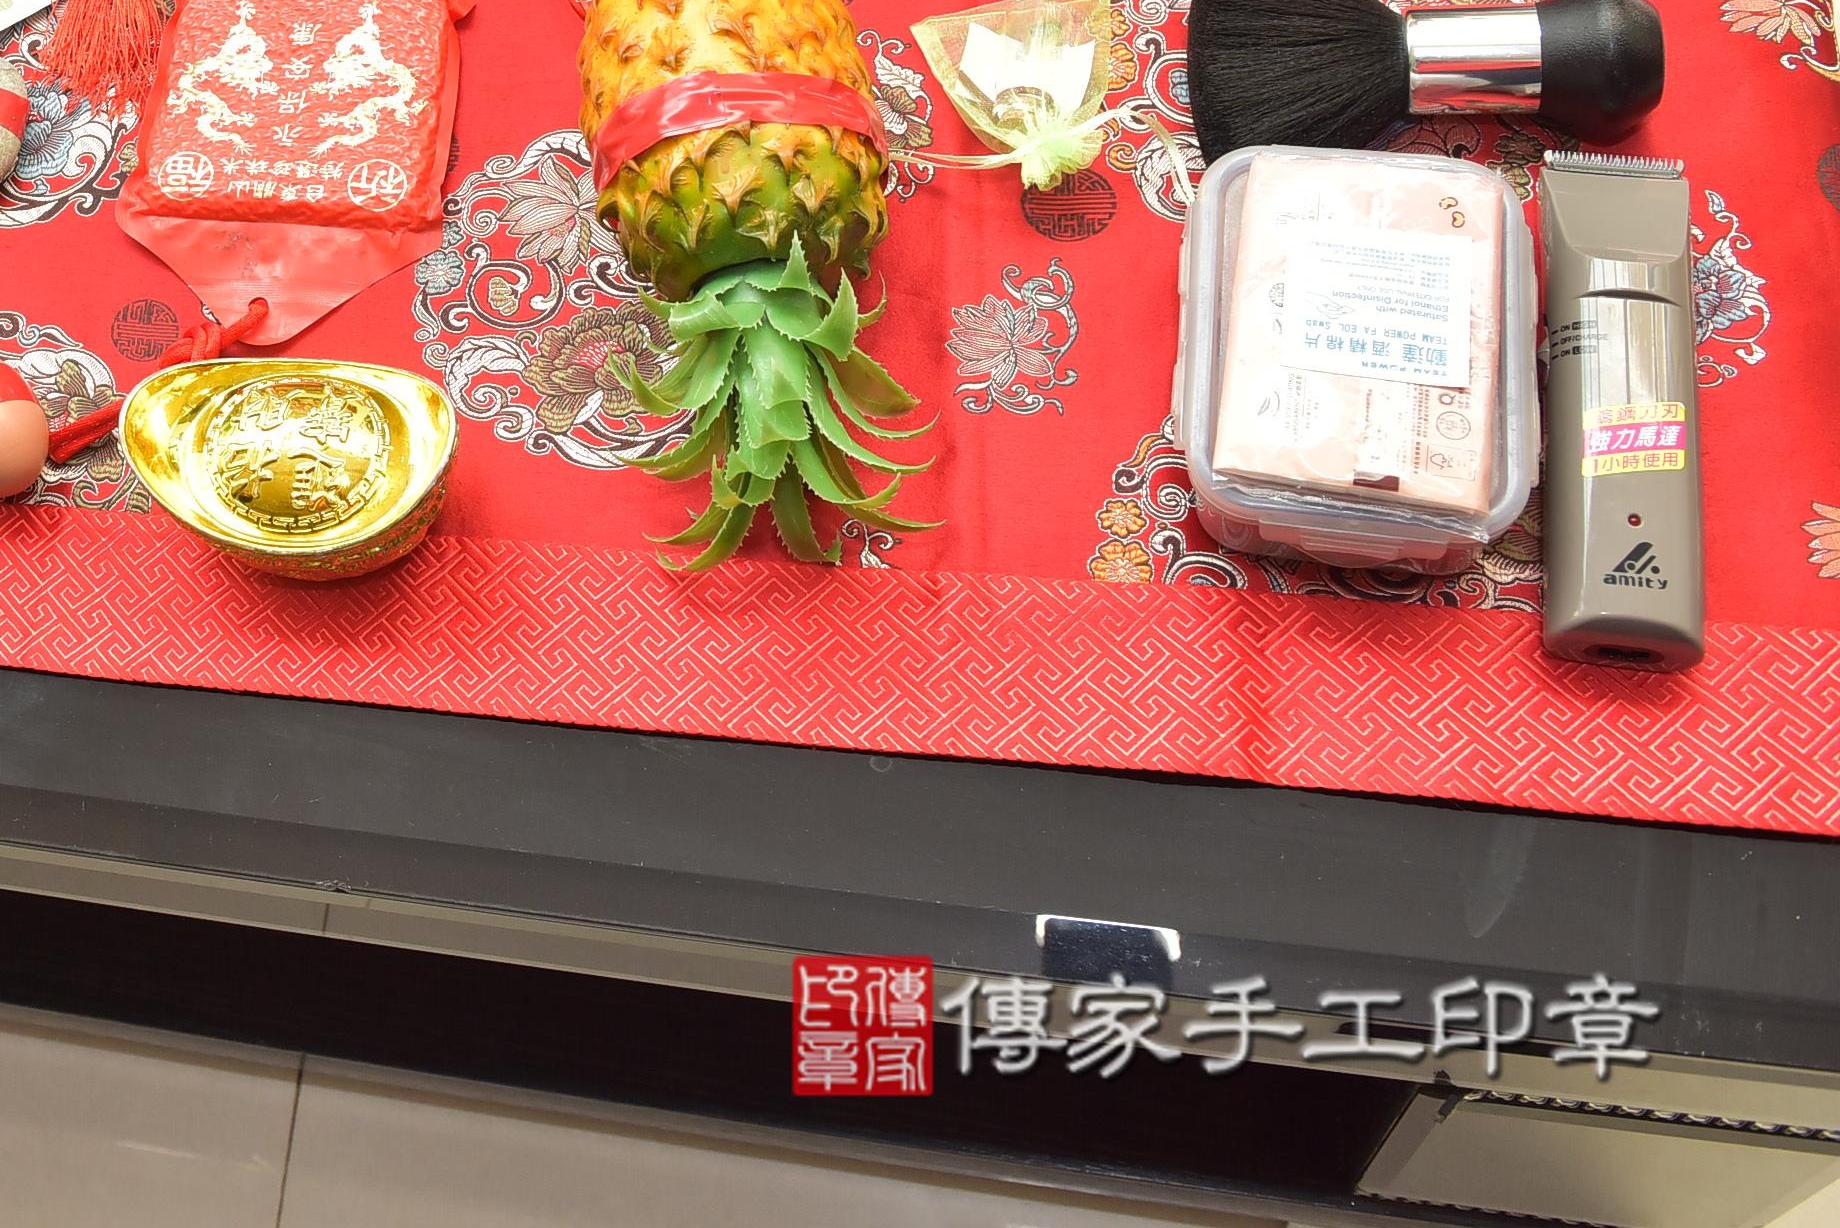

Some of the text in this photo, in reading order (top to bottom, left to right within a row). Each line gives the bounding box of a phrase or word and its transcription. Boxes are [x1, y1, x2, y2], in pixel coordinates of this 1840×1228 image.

[272, 21, 322, 147] 永保安康
[161, 156, 212, 196] 福
[220, 157, 345, 182] 特選珍珠米
[1332, 291, 1448, 313] Ethanol for Disinfection
[1376, 306, 1448, 322] Saturated with
[1305, 319, 1331, 330] Swab
[1364, 326, 1376, 334] FA
[1560, 324, 1571, 333] ON
[1383, 329, 1416, 340] POWER
[1422, 334, 1448, 345] TEAM
[1560, 333, 1608, 345] OFF/CHARGE
[1304, 333, 1448, 366] 勤達 酒精棉片
[1560, 348, 1571, 358] ON
[1361, 361, 1447, 377] TEAM POWER
[1586, 425, 1682, 453] 強力馬達
[1593, 452, 1678, 473] 1小時使用
[1603, 573, 1668, 590] amity
